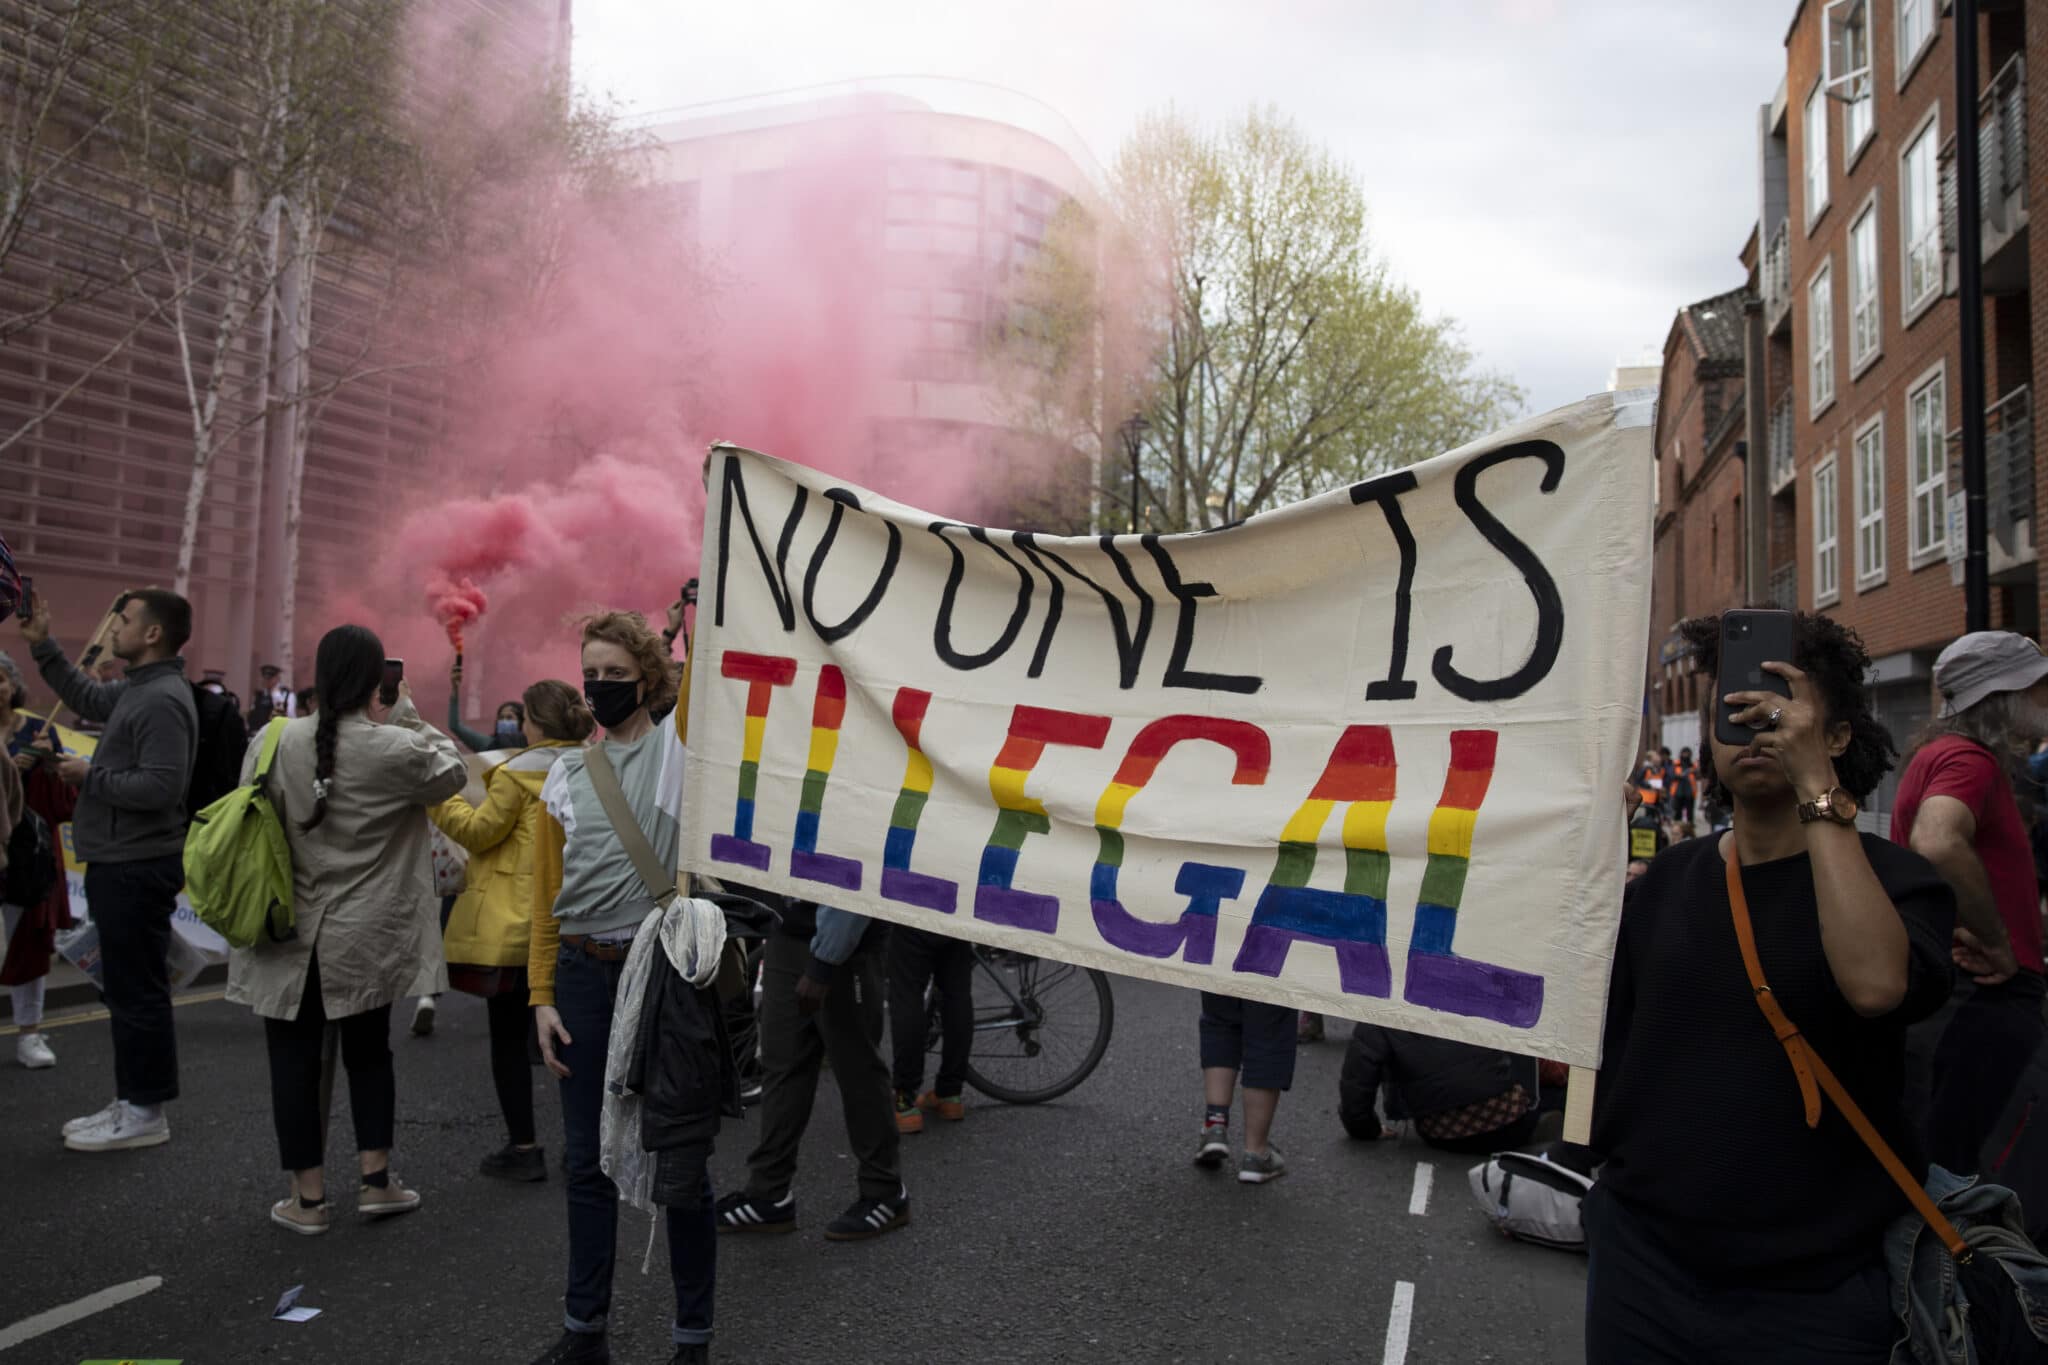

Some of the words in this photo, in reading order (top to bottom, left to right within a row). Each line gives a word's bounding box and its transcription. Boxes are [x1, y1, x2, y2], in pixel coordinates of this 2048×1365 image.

[715, 456, 902, 645] NO
[928, 519, 1262, 693] ONE
[1350, 439, 1565, 701] IS
[710, 649, 1544, 1029] ILLEGAL
